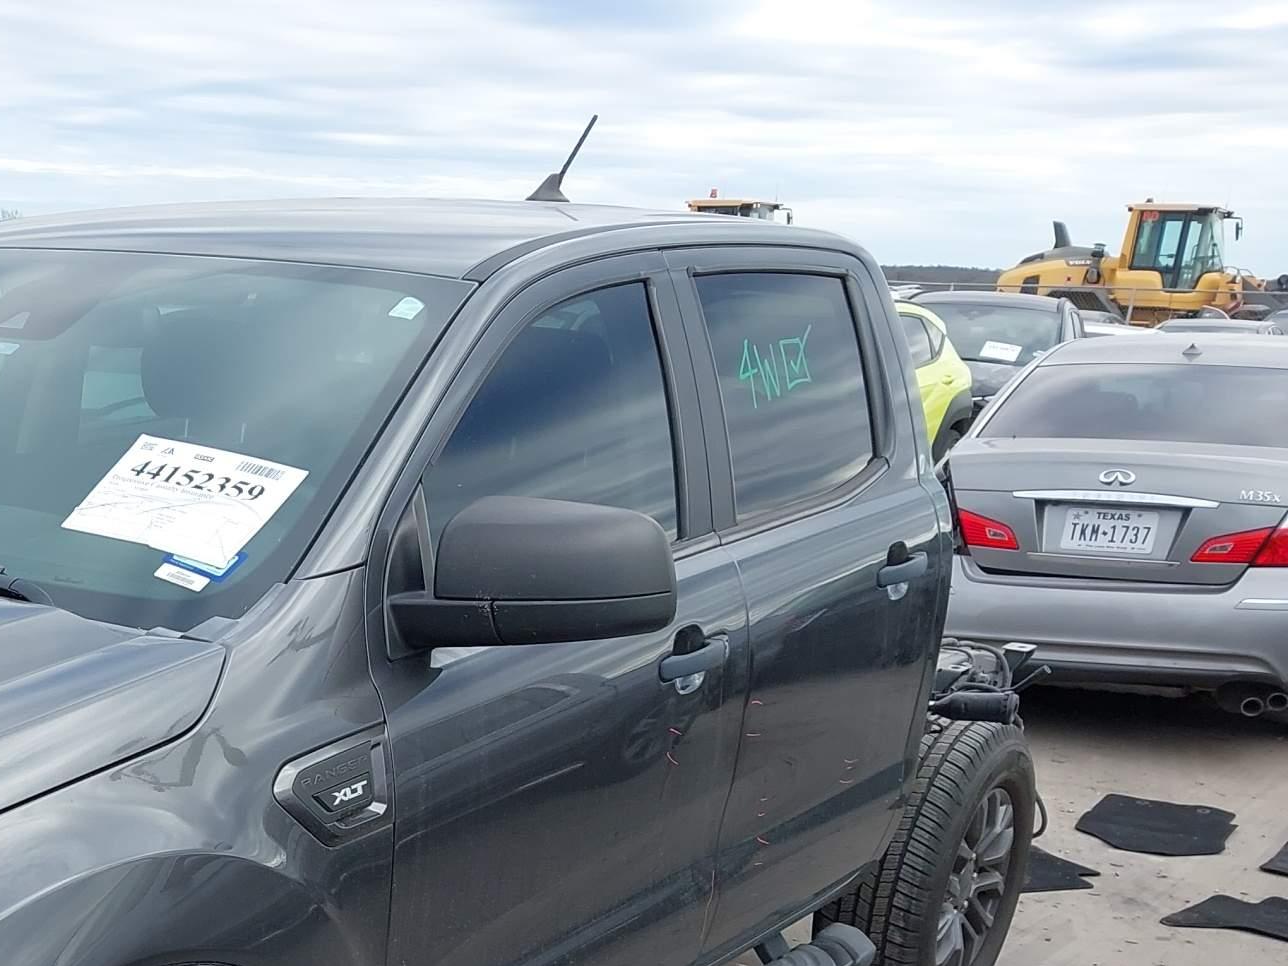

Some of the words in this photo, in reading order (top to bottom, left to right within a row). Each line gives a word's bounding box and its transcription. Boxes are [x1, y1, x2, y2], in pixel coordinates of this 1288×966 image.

[130, 460, 266, 501] 44152359
[1239, 490, 1281, 503] M35x
[1096, 511, 1131, 521] TEXAS
[332, 780, 368, 806] XLT
